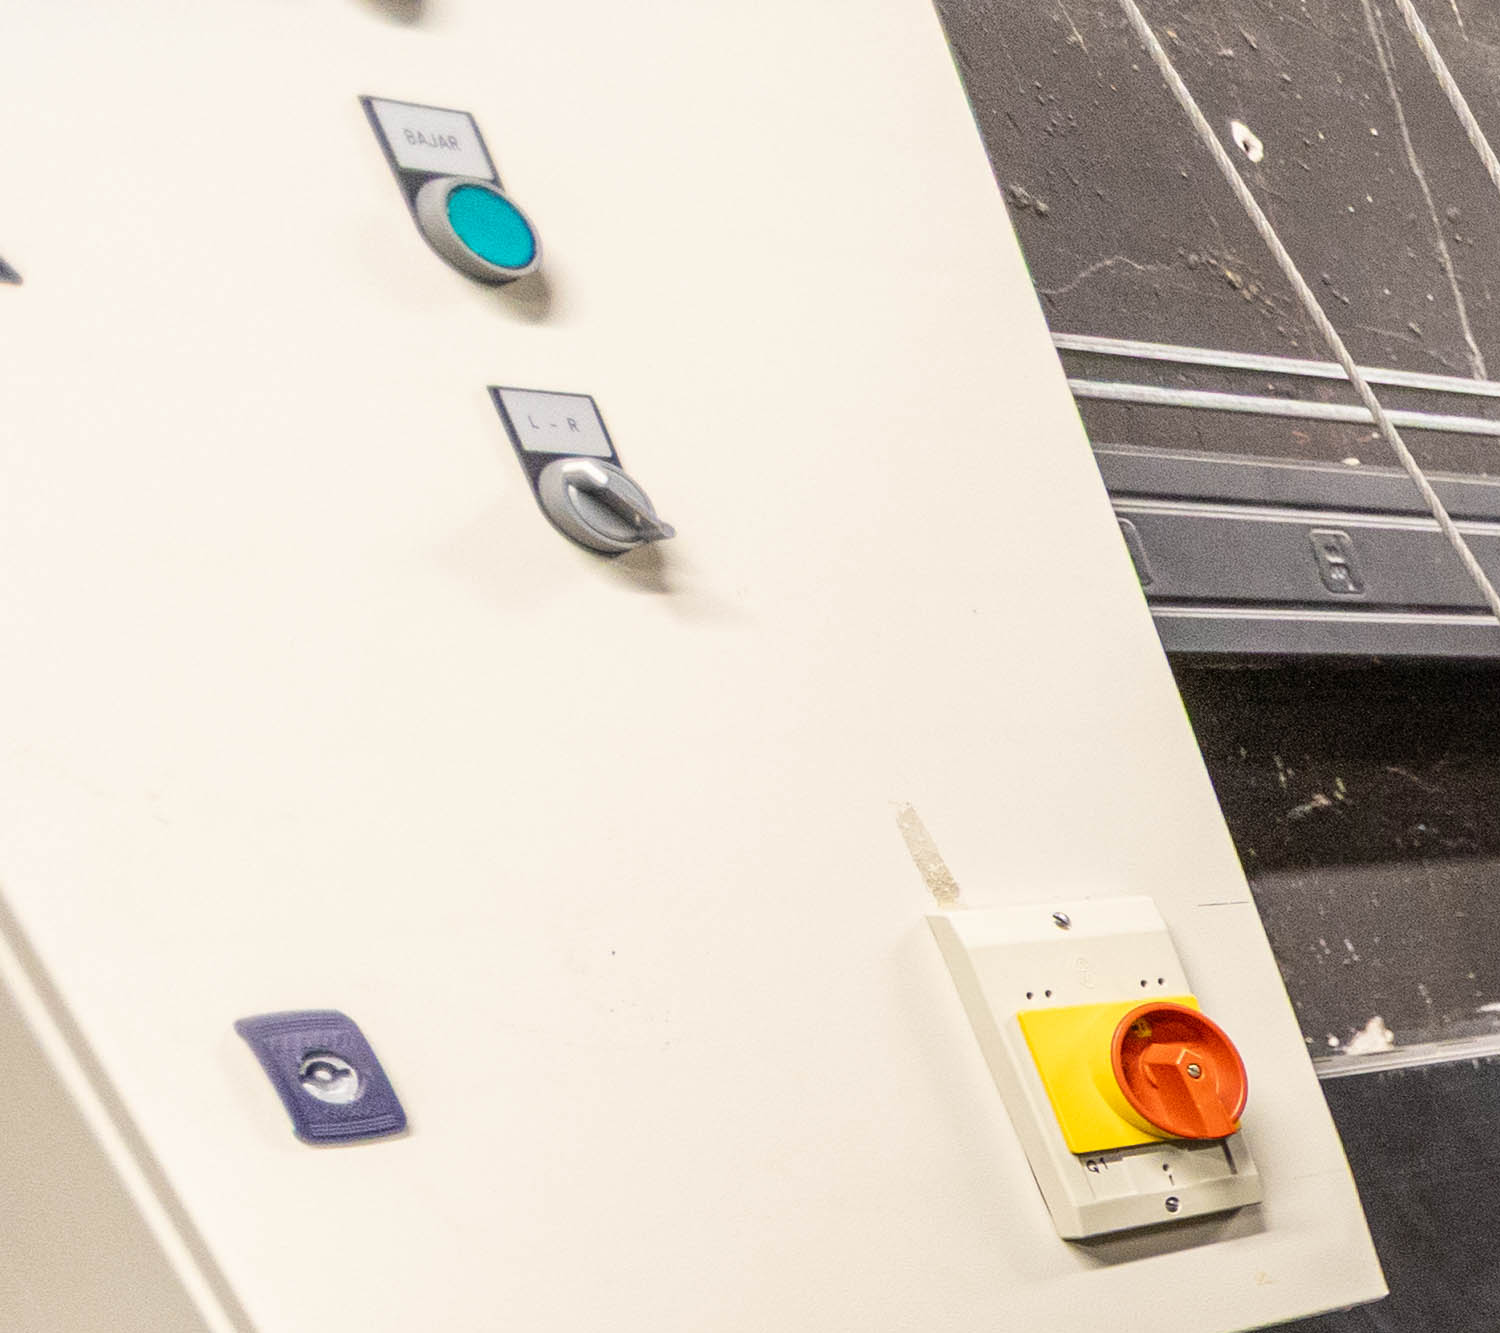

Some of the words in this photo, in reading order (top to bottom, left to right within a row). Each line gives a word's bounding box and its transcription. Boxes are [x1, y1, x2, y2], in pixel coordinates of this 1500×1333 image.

[402, 128, 463, 151] BAJAR
[527, 415, 541, 430] L
[566, 416, 581, 433] R
